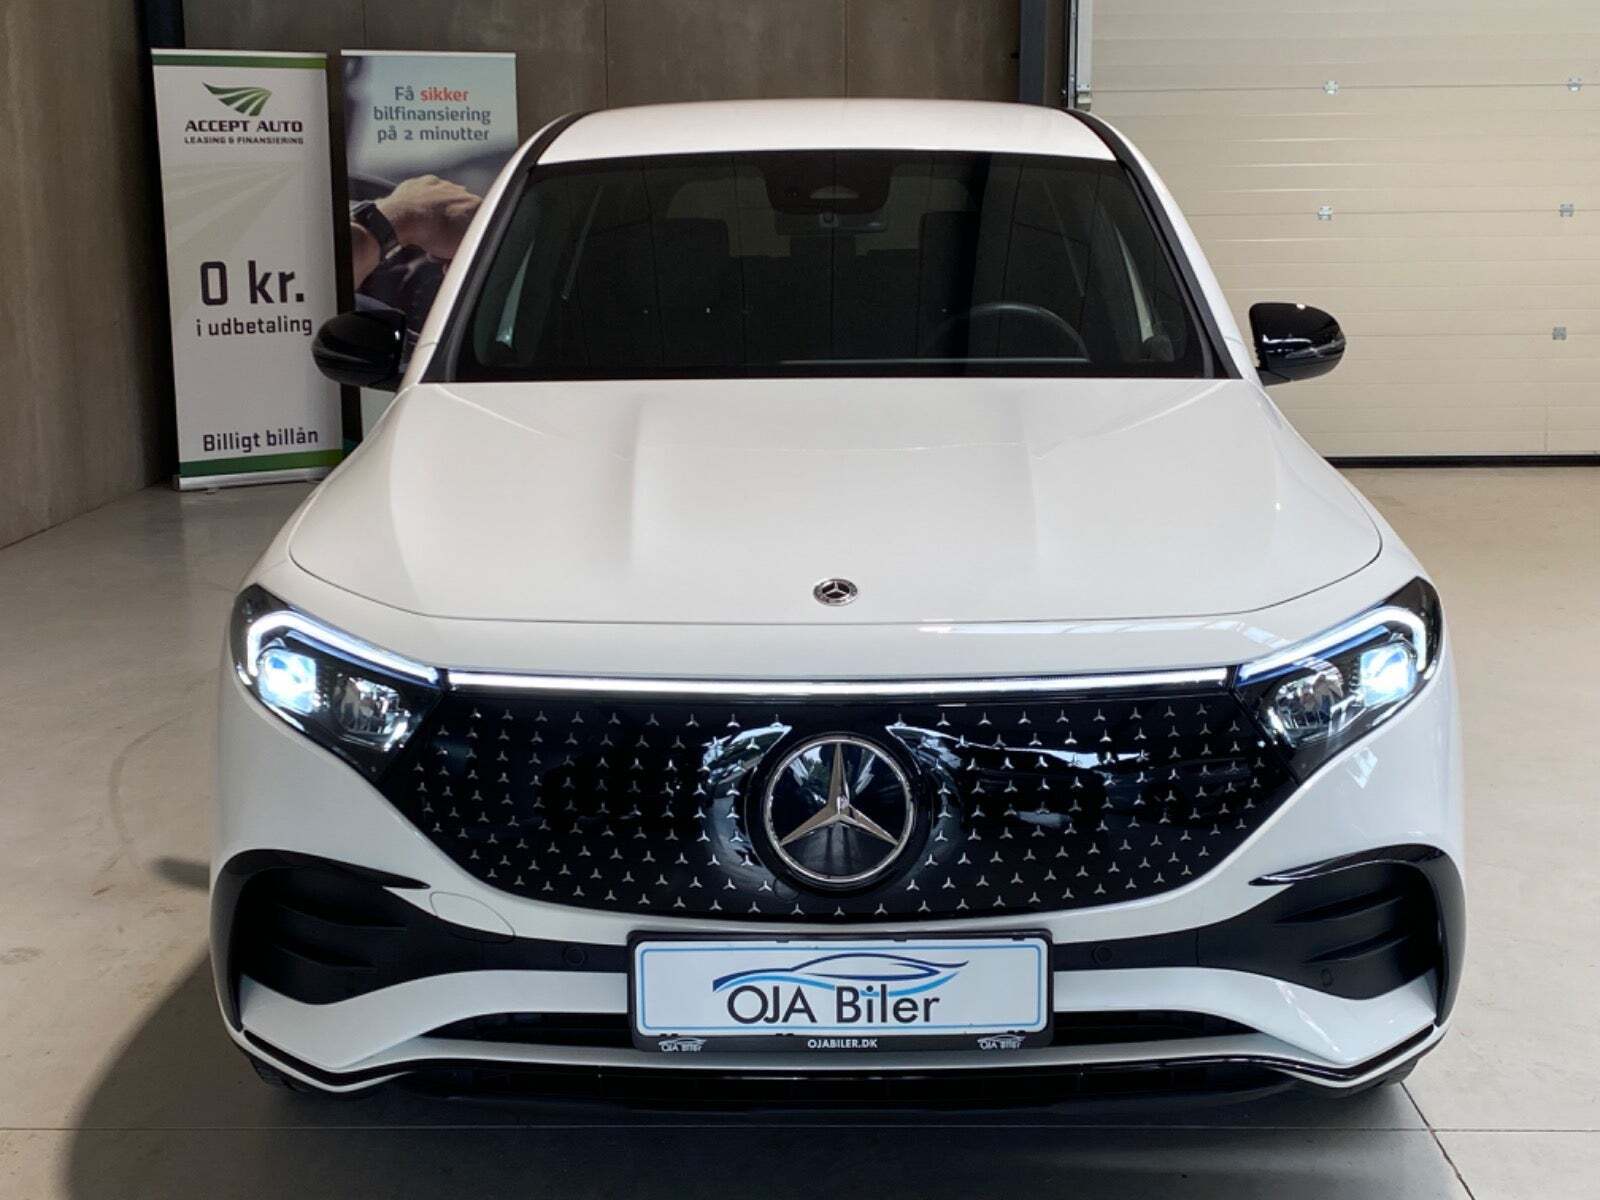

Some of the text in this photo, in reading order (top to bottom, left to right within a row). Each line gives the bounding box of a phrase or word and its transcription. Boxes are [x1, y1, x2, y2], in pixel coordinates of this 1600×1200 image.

[394, 86, 469, 102] Få sikker
[374, 106, 492, 125] bilfinansiering
[185, 120, 303, 132] ACCEPT AUTO
[377, 125, 490, 144] på 2 minutter
[184, 136, 226, 145] LEASING
[237, 136, 304, 145] FINANSIERING
[200, 260, 305, 306] 0 kr.
[196, 316, 313, 336] i udbetaling
[203, 427, 319, 453] Billigt billån
[726, 984, 940, 1025] OJA Biler
[807, 1038, 878, 1049] OJABILER.DK
